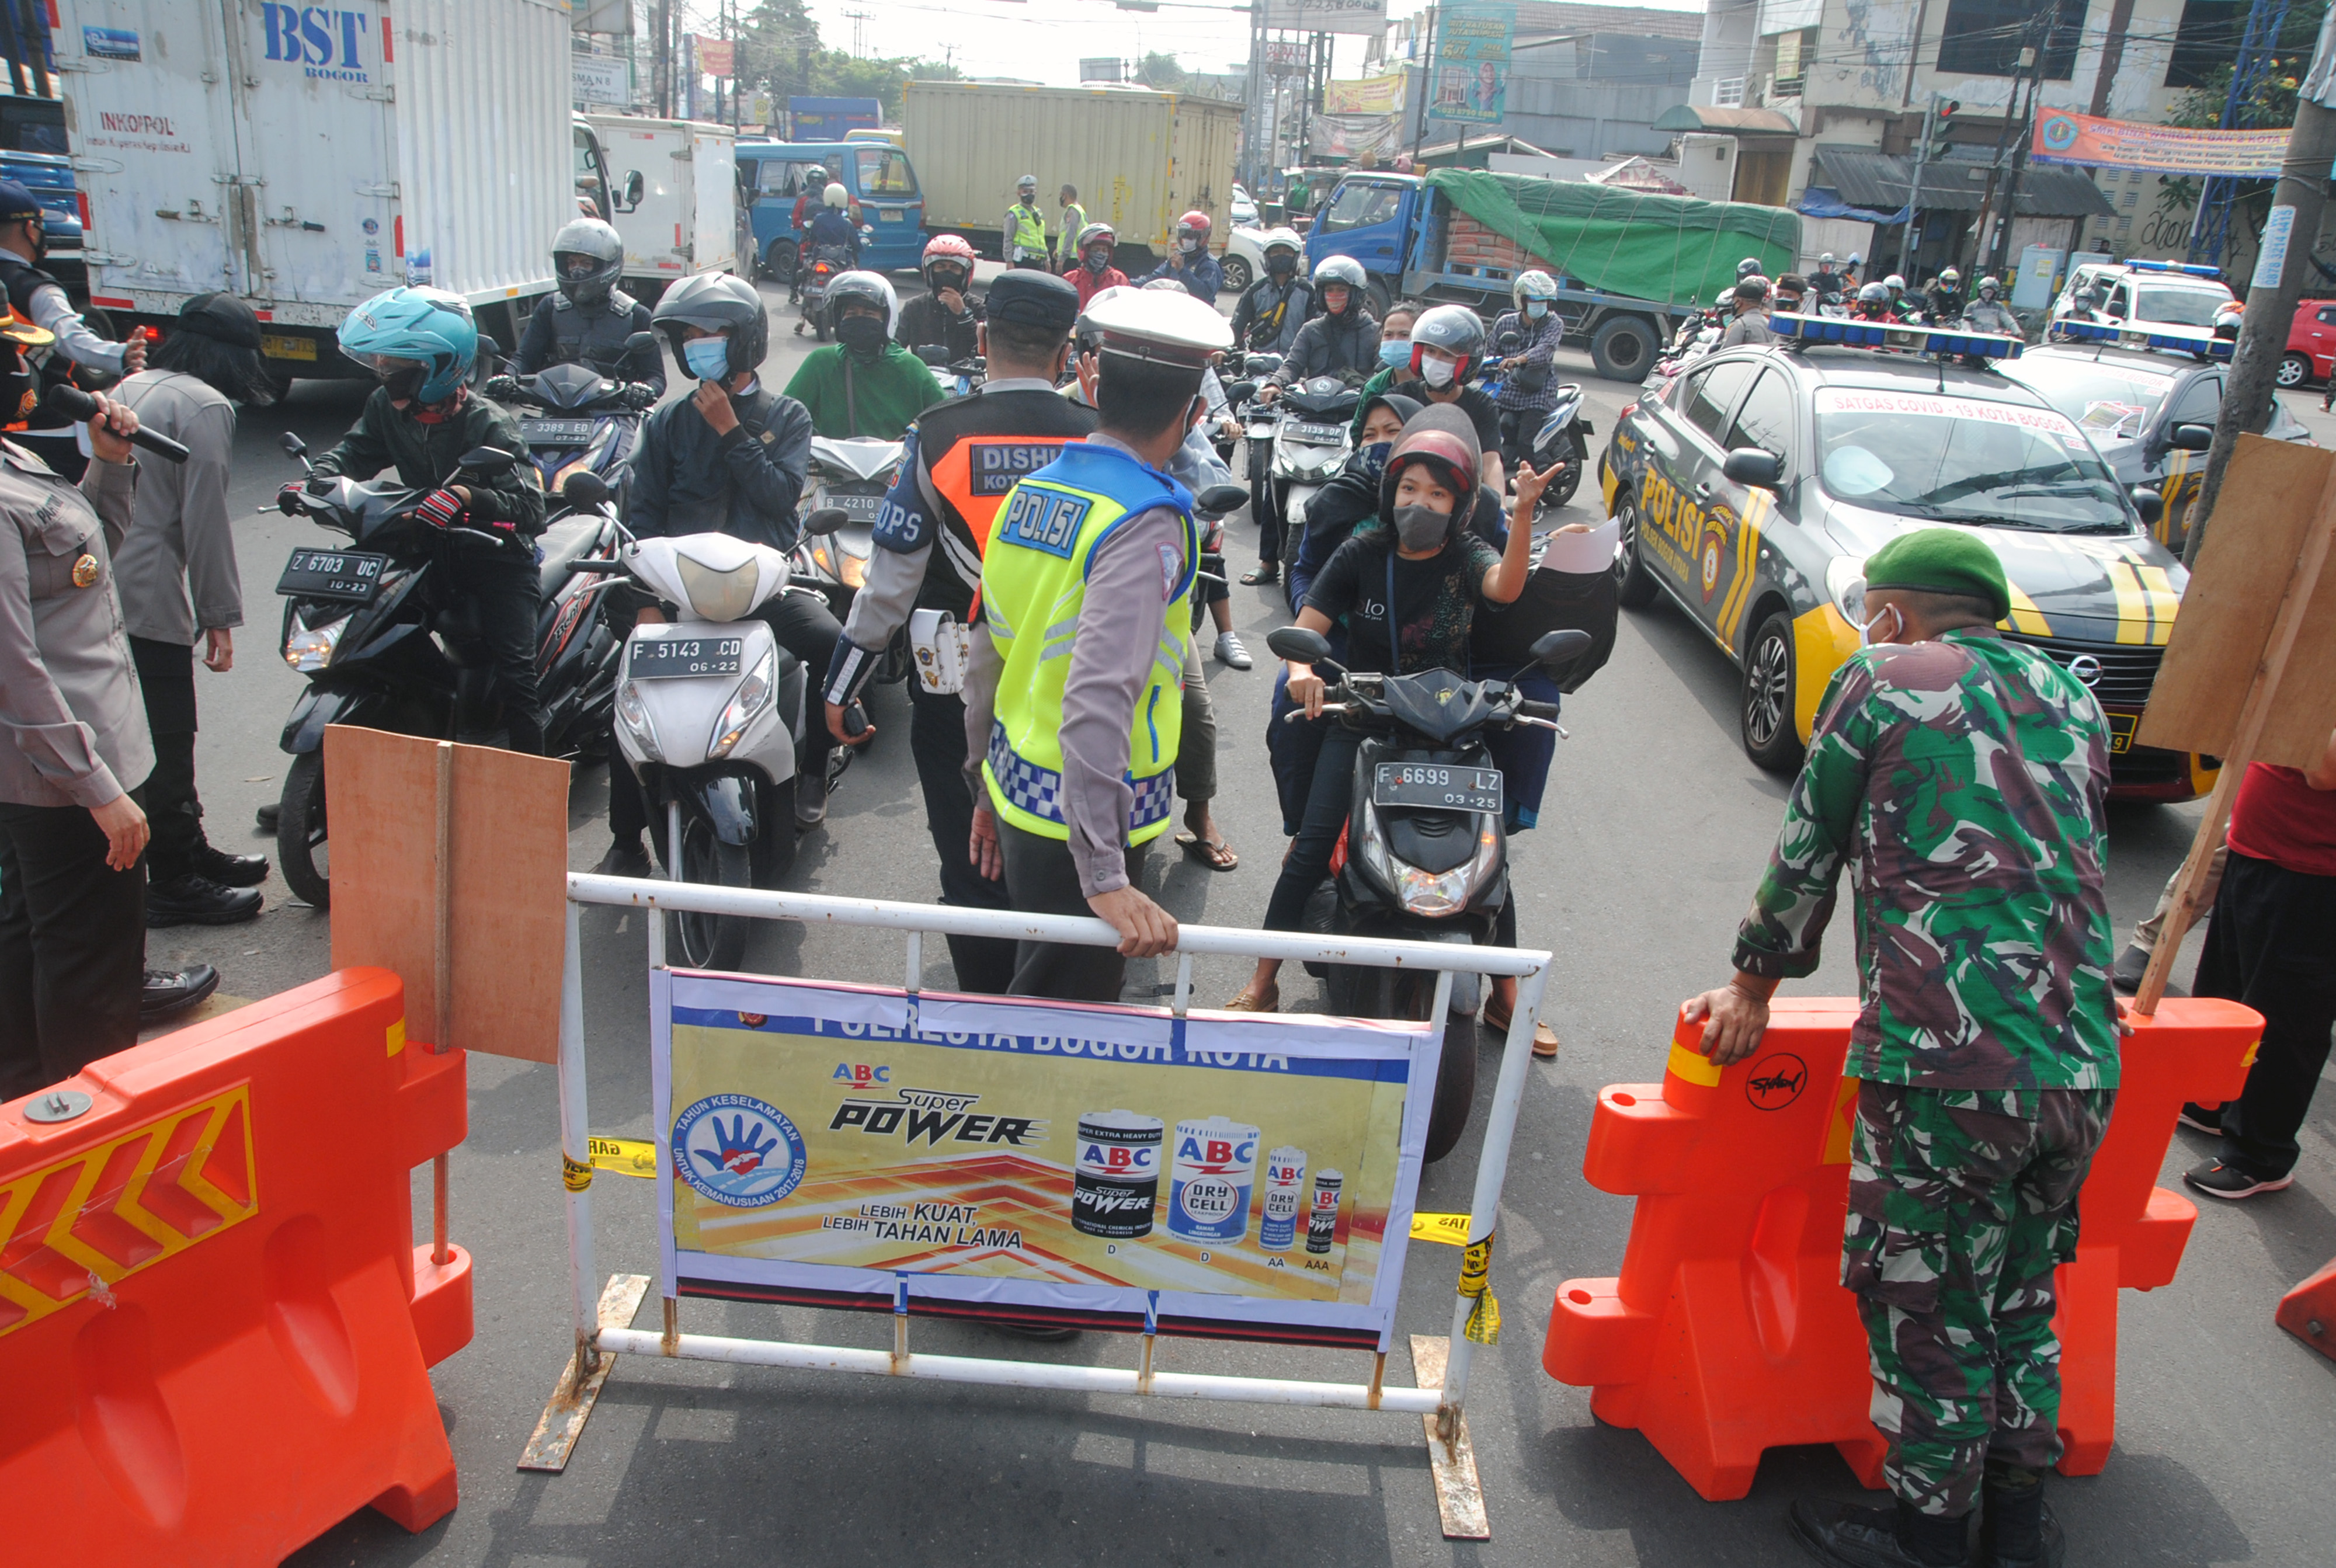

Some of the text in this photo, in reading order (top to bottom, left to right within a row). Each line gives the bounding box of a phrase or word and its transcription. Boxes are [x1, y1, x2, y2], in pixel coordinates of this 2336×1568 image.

[260, 2, 366, 68] BST
[305, 67, 369, 83] BOGOR
[2089, 124, 2115, 135] SMK
[2118, 127, 2146, 138] BINA
[2265, 209, 2294, 286] 0878 3214 4415
[1835, 397, 1893, 410] SATGAS
[1897, 399, 1944, 414] COVID
[1956, 404, 1974, 417] 19
[1978, 407, 2016, 423] KOTA
[2019, 413, 2070, 434] BOGOR
[521, 423, 588, 433] F 3389 ED
[1329, 427, 1341, 436] DP
[984, 474, 1022, 489] KOT
[827, 498, 874, 509] B 4210
[1640, 467, 1705, 561] POLISI
[877, 499, 922, 542] OPS
[1004, 492, 1083, 550] POLISI
[1640, 520, 1690, 584] POLSEK BOGOR UTARA
[292, 555, 377, 576] Z 6703 UC
[633, 640, 740, 659] F 5143 CD
[1379, 767, 1499, 790] F 6699 LZ
[833, 1062, 890, 1083] ABC
[898, 1088, 979, 1111] Super
[676, 1095, 799, 1141] TAHUN KESELAMATAN
[828, 1103, 1051, 1148] POWER
[1095, 1129, 1121, 1138] EXTRA
[1083, 1144, 1152, 1167] ABC
[1178, 1136, 1254, 1163] ABC
[673, 1148, 805, 1207] UNTUK KEMANUSIAAN 2017-2018
[1268, 1166, 1305, 1180] ABC
[1096, 1185, 1135, 1198] Super
[1193, 1184, 1228, 1197] DRY
[1271, 1194, 1294, 1203] DRY
[1073, 1190, 1152, 1214] POWER
[1190, 1198, 1228, 1212] CELL
[1268, 1203, 1293, 1212] CELL
[860, 1203, 978, 1226] LEBIH KUAT,
[822, 1216, 1021, 1249] LEBIH TAHAN LAMA
[1108, 1245, 1116, 1254] D
[1201, 1251, 1209, 1263] D
[1268, 1258, 1284, 1267] AA
[1305, 1260, 1329, 1270] AAA
